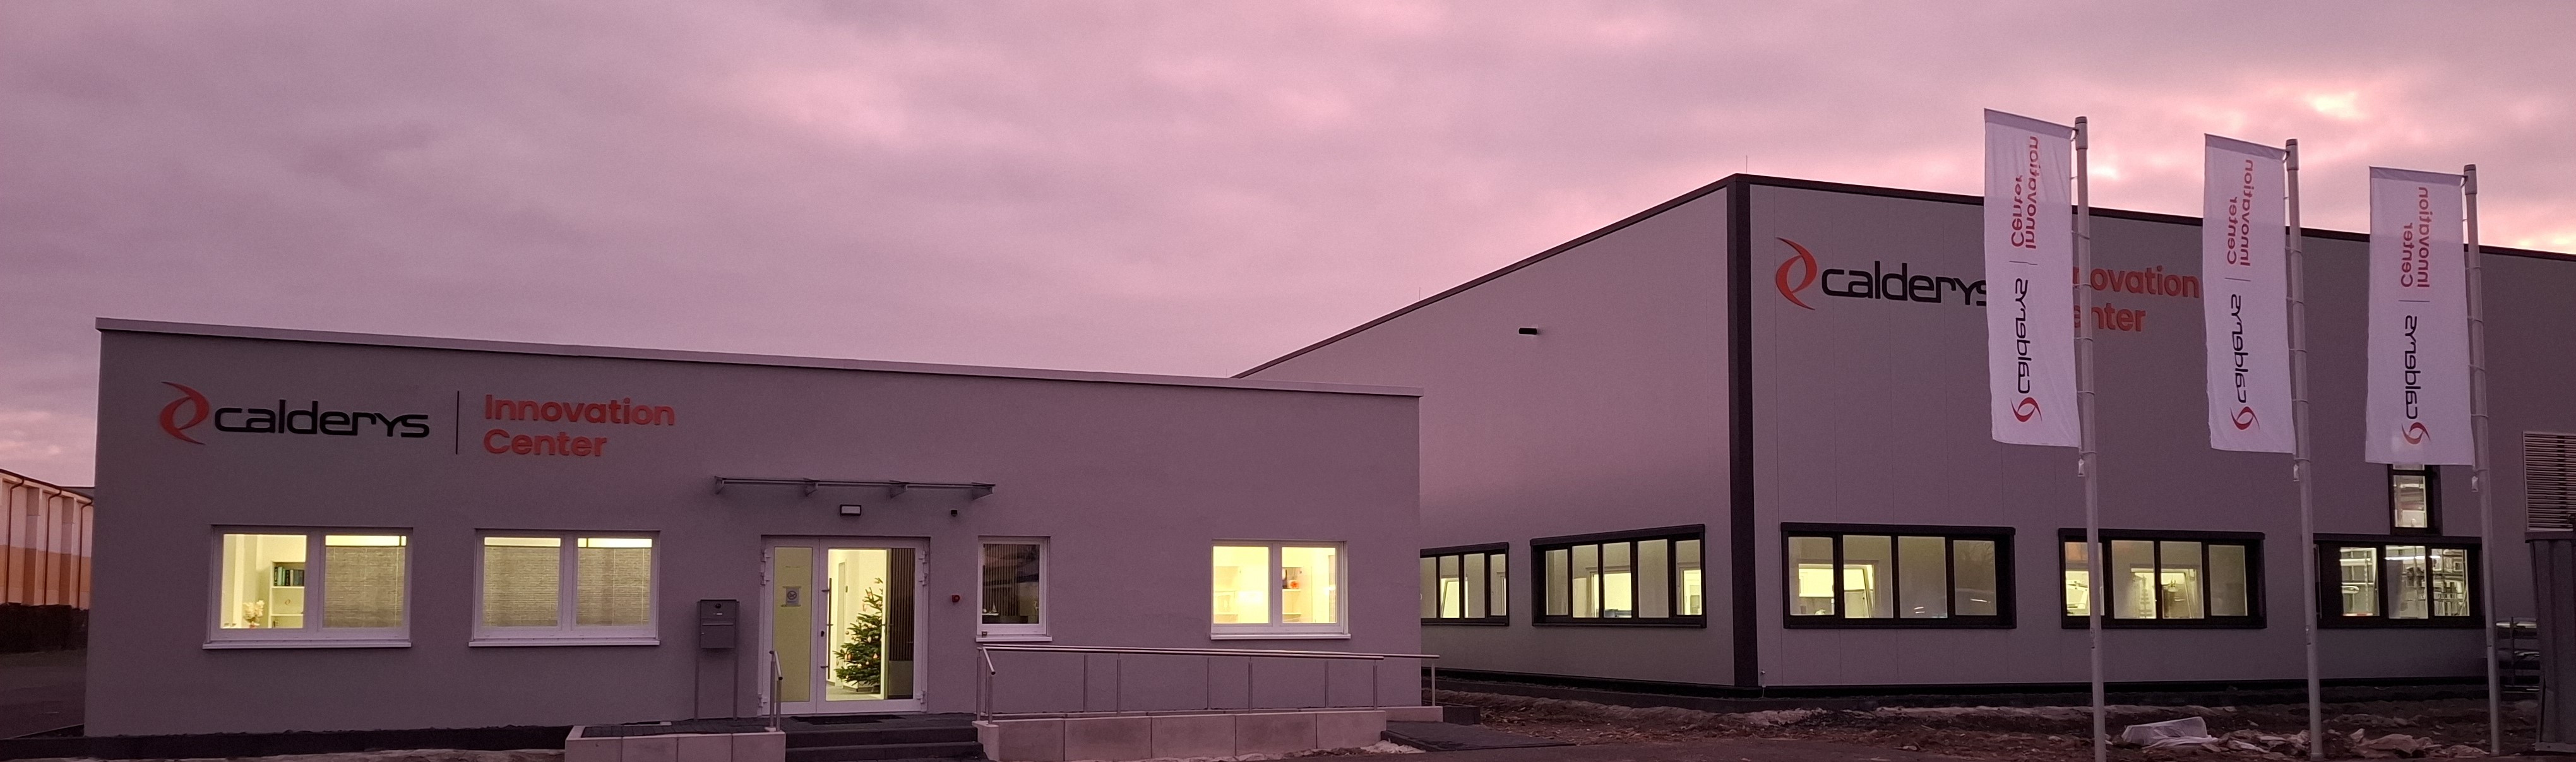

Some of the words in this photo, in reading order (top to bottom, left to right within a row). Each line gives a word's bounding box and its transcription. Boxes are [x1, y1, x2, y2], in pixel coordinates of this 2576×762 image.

[2073, 265, 2200, 299] ovation
[2074, 302, 2147, 332] nter
[214, 399, 430, 438] calderys
[484, 394, 676, 426] Innovation
[483, 428, 608, 457] Center
